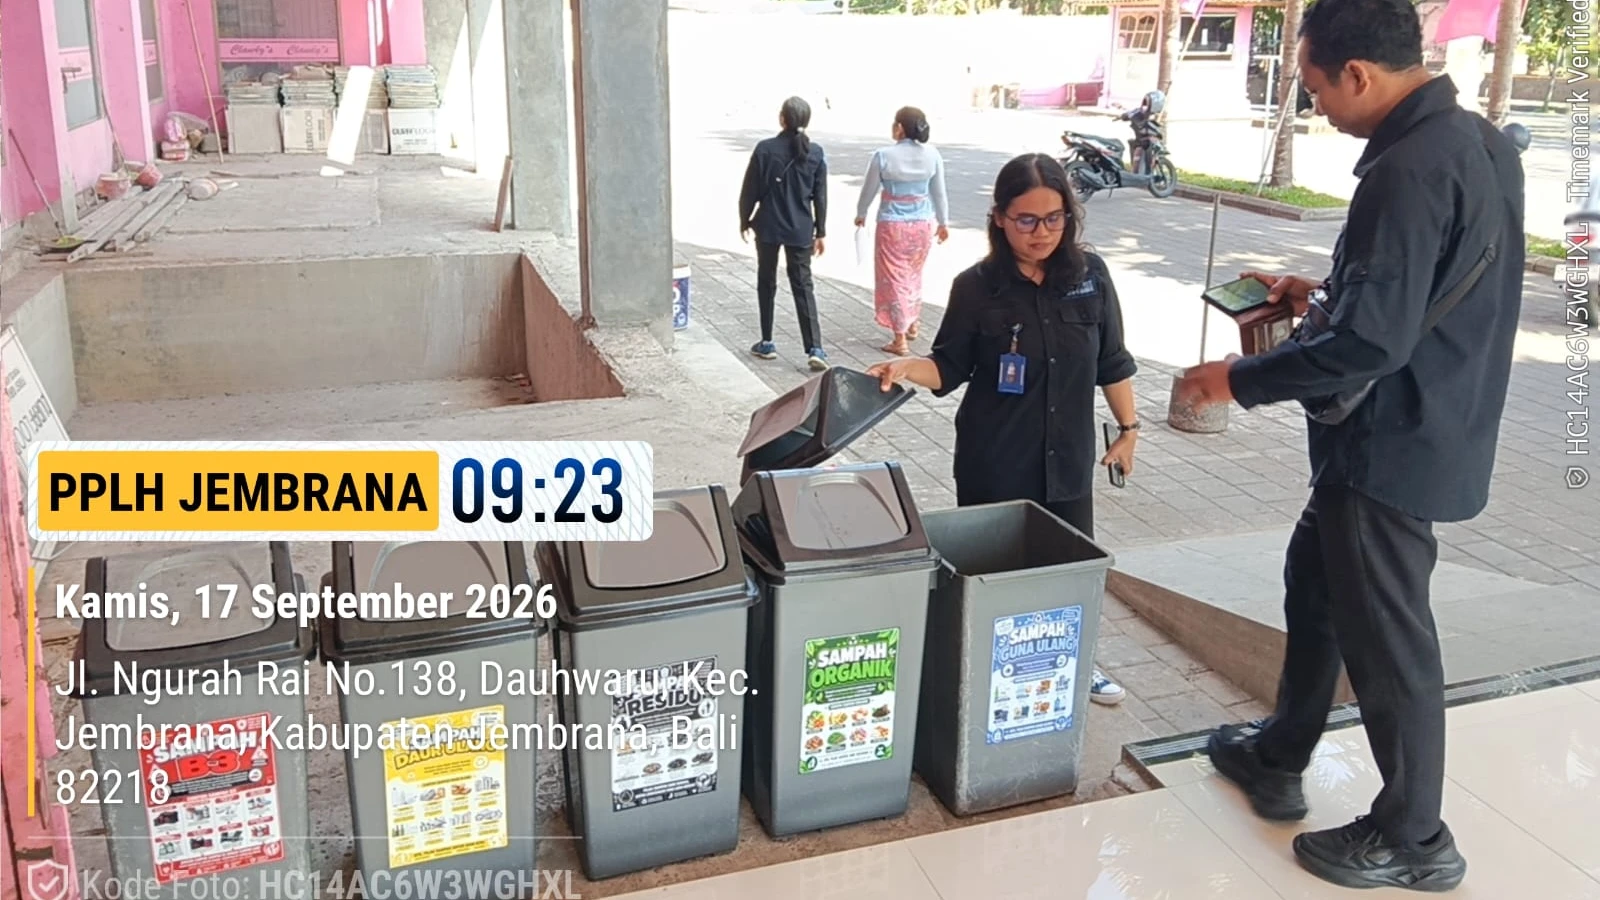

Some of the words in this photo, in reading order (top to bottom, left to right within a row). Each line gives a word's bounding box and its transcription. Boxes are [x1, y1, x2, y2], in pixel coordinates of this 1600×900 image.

[1009, 622, 1066, 646] SAMPAH
[817, 641, 888, 669] SAMPAH
[1000, 641, 1034, 663] GUNA
[1035, 637, 1075, 654] ULANG
[810, 659, 893, 690] ORGANIK
[626, 688, 702, 717] RESIDU
